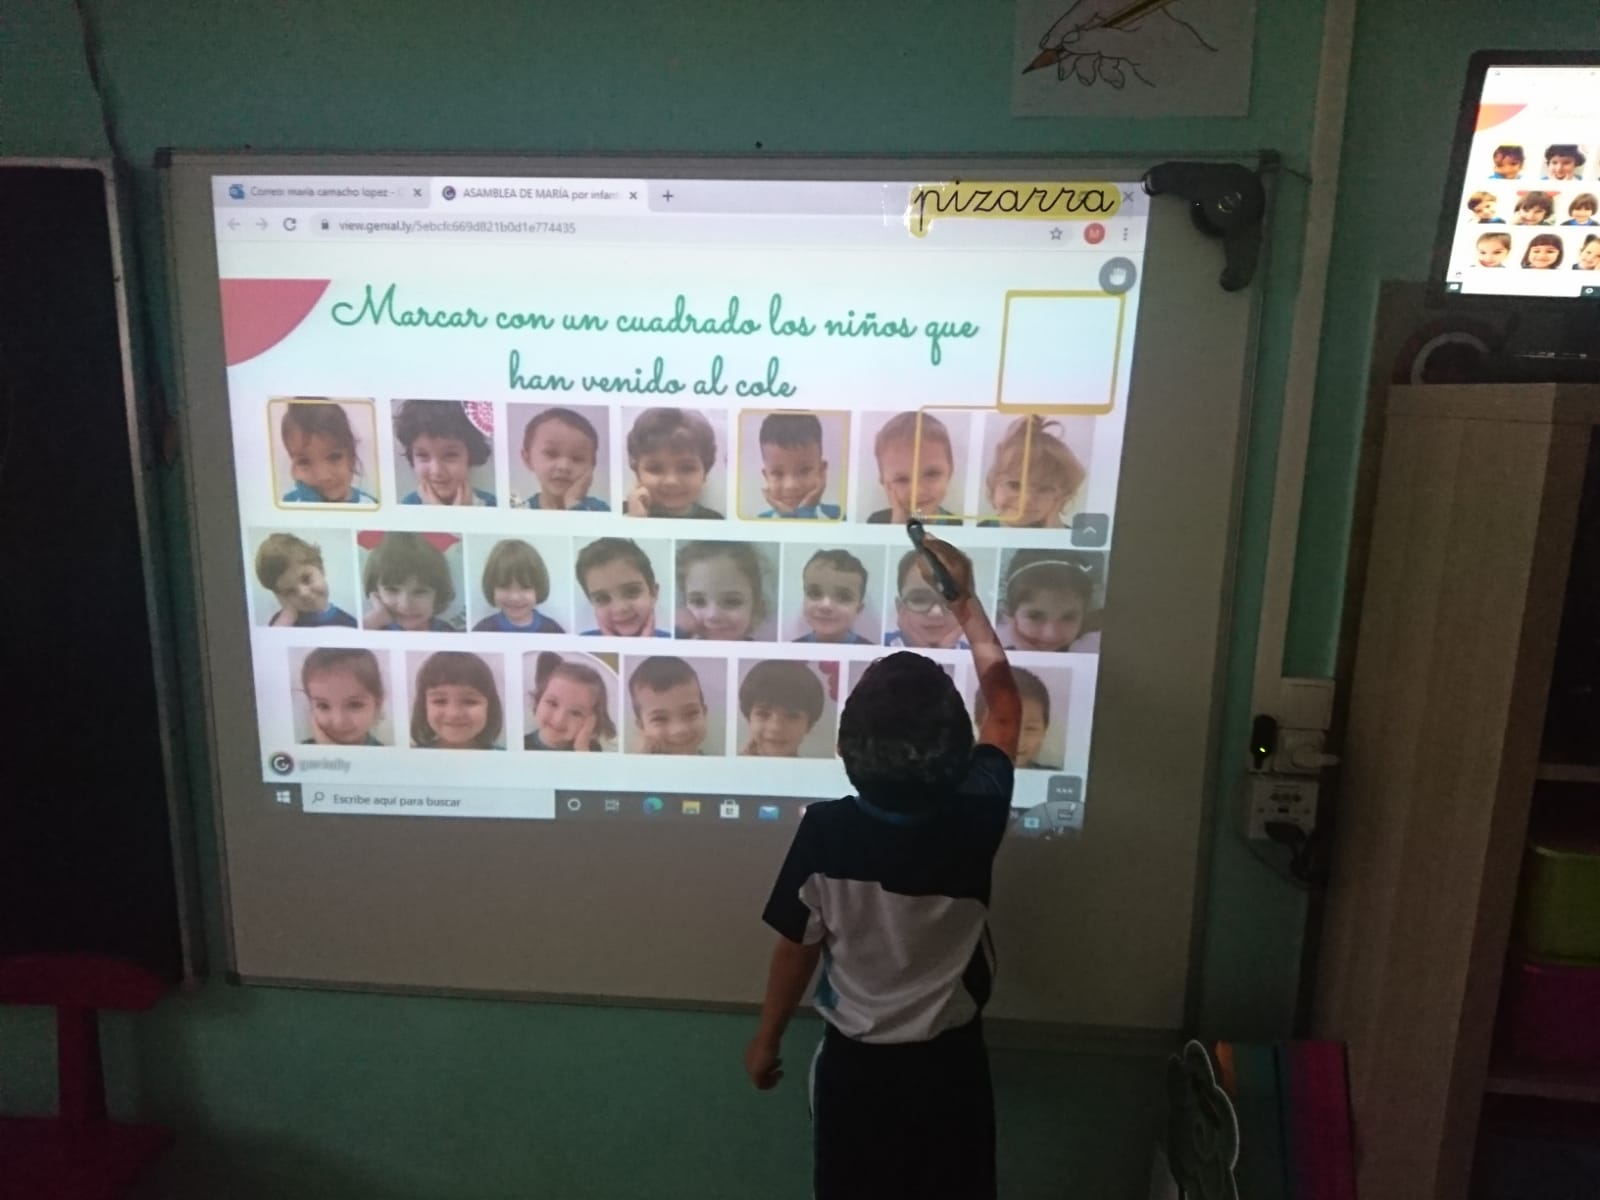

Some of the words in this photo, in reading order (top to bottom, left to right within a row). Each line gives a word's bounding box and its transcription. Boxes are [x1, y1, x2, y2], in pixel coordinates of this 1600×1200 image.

[317, 187, 360, 197] camacho
[463, 187, 517, 199] ASAMBLEA
[519, 188, 533, 199] DE
[571, 192, 588, 201] por
[913, 180, 1115, 232] pizarra
[331, 283, 489, 328] Marcar
[495, 309, 555, 330] con
[562, 311, 609, 332] un
[616, 294, 762, 335] cuadrado
[768, 293, 817, 337] los
[823, 309, 919, 339] niños
[924, 316, 979, 366] que
[508, 349, 575, 391] han
[581, 356, 687, 395] venido
[693, 354, 728, 396] al
[734, 355, 798, 398] cole
[333, 794, 372, 805] Escribe
[400, 798, 423, 807] para
[426, 796, 462, 808] buscar
